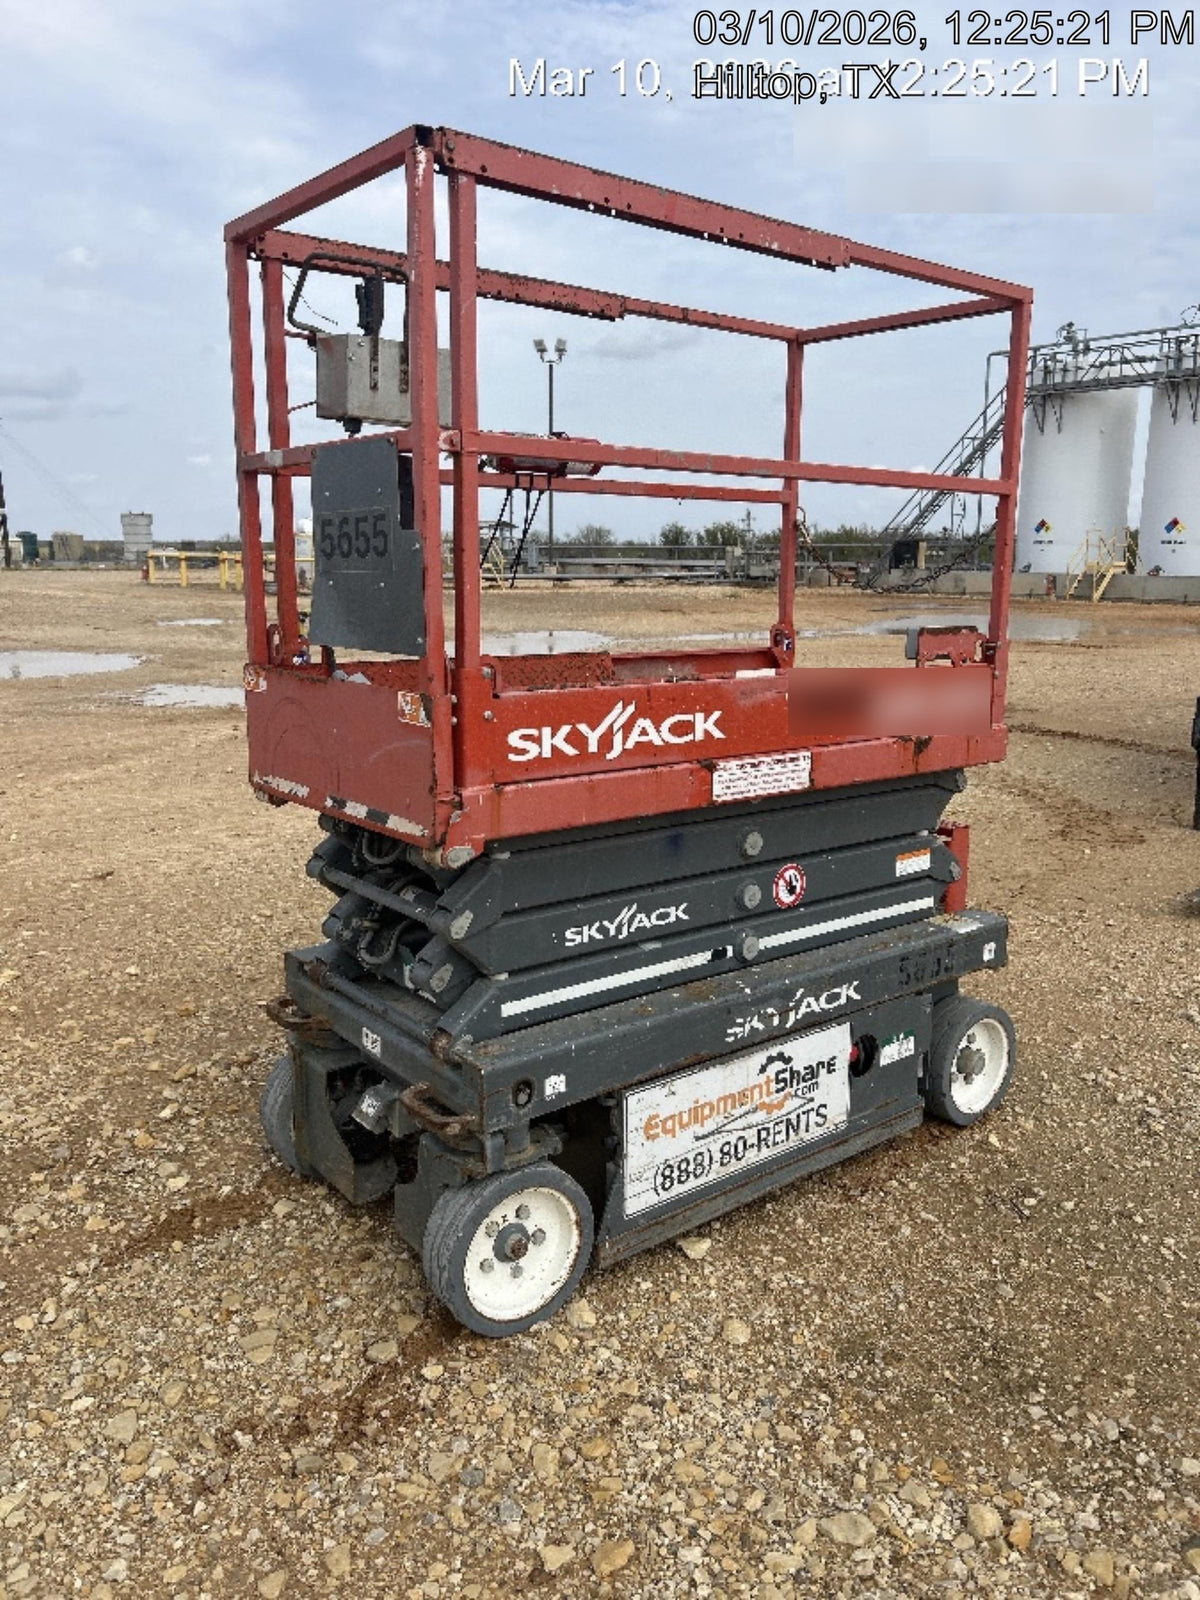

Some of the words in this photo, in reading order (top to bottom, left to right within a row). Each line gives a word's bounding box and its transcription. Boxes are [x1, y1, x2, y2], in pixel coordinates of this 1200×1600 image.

[320, 513, 389, 561] 5655
[507, 700, 727, 762] SKYJACK
[564, 902, 691, 947] SKYJACK
[653, 1147, 714, 1198] (888)
[719, 1103, 829, 1168] 80-RENTS
